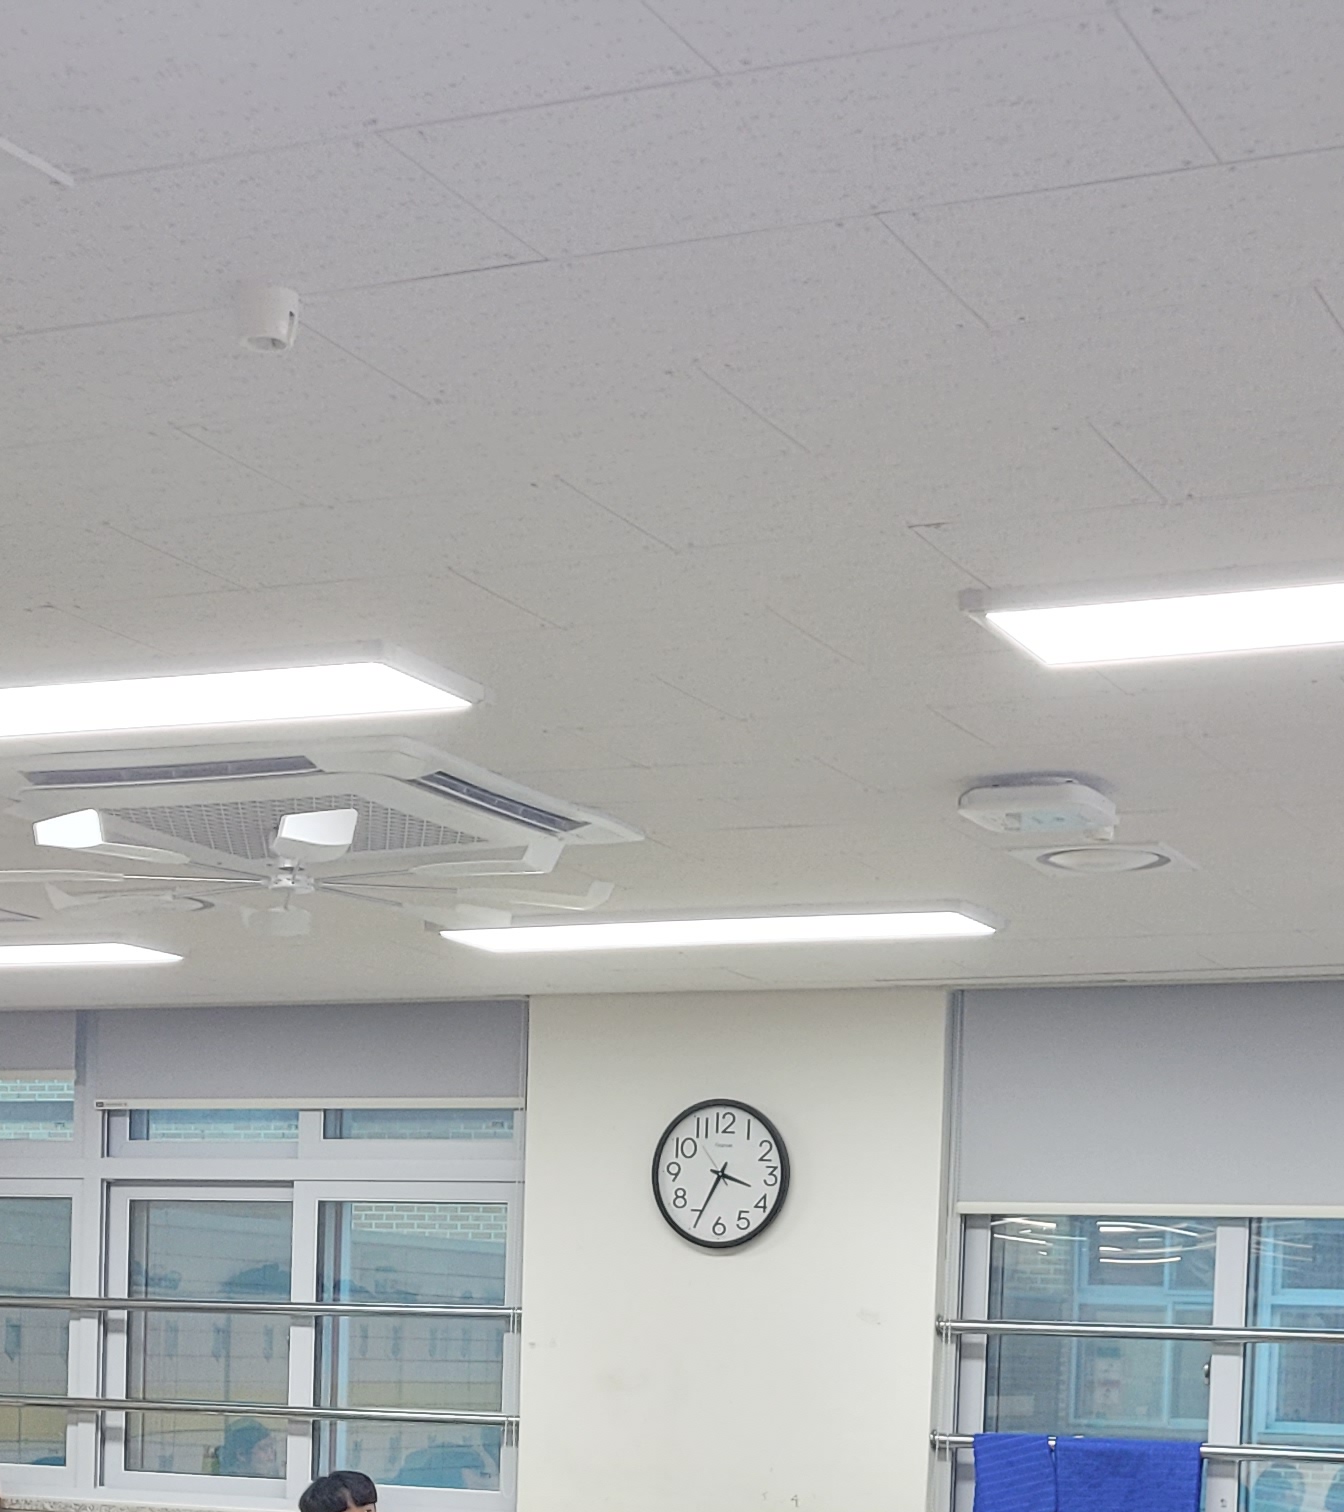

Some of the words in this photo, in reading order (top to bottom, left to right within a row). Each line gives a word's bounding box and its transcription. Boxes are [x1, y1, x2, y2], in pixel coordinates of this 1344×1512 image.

[696, 1117, 709, 1139] 11
[715, 1112, 736, 1134] 12
[746, 1118, 751, 1141] 1
[675, 1137, 698, 1159] 10
[758, 1139, 773, 1162] 2
[666, 1161, 681, 1183] 9
[763, 1165, 779, 1187] 3
[672, 1187, 688, 1209] 8
[753, 1193, 768, 1213] 4
[691, 1208, 704, 1229] 7
[712, 1216, 727, 1236] 6
[736, 1210, 751, 1230] 5
